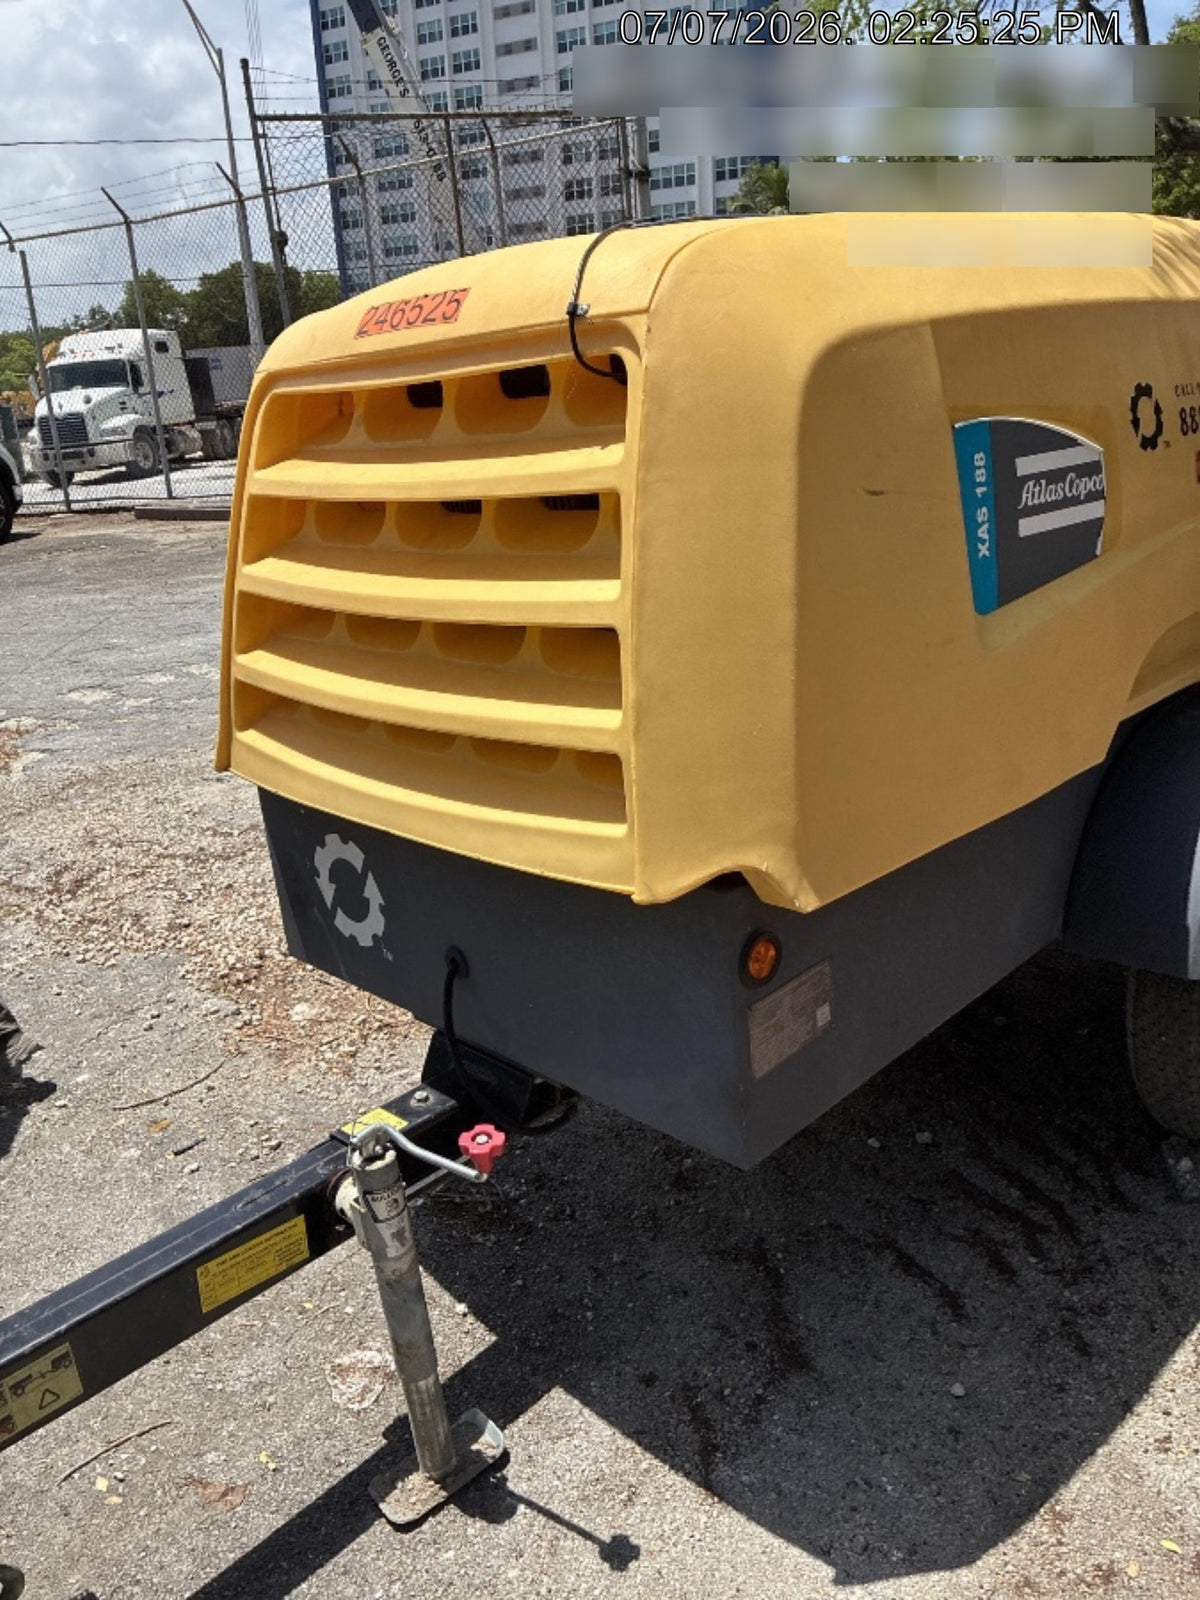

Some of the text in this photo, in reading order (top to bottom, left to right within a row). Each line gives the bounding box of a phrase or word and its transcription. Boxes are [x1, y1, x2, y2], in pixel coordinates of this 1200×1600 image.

[376, 36, 410, 98] GEORGE'S
[355, 287, 471, 338] 246525
[1179, 405, 1200, 436] 88
[973, 451, 990, 558] XAS 188
